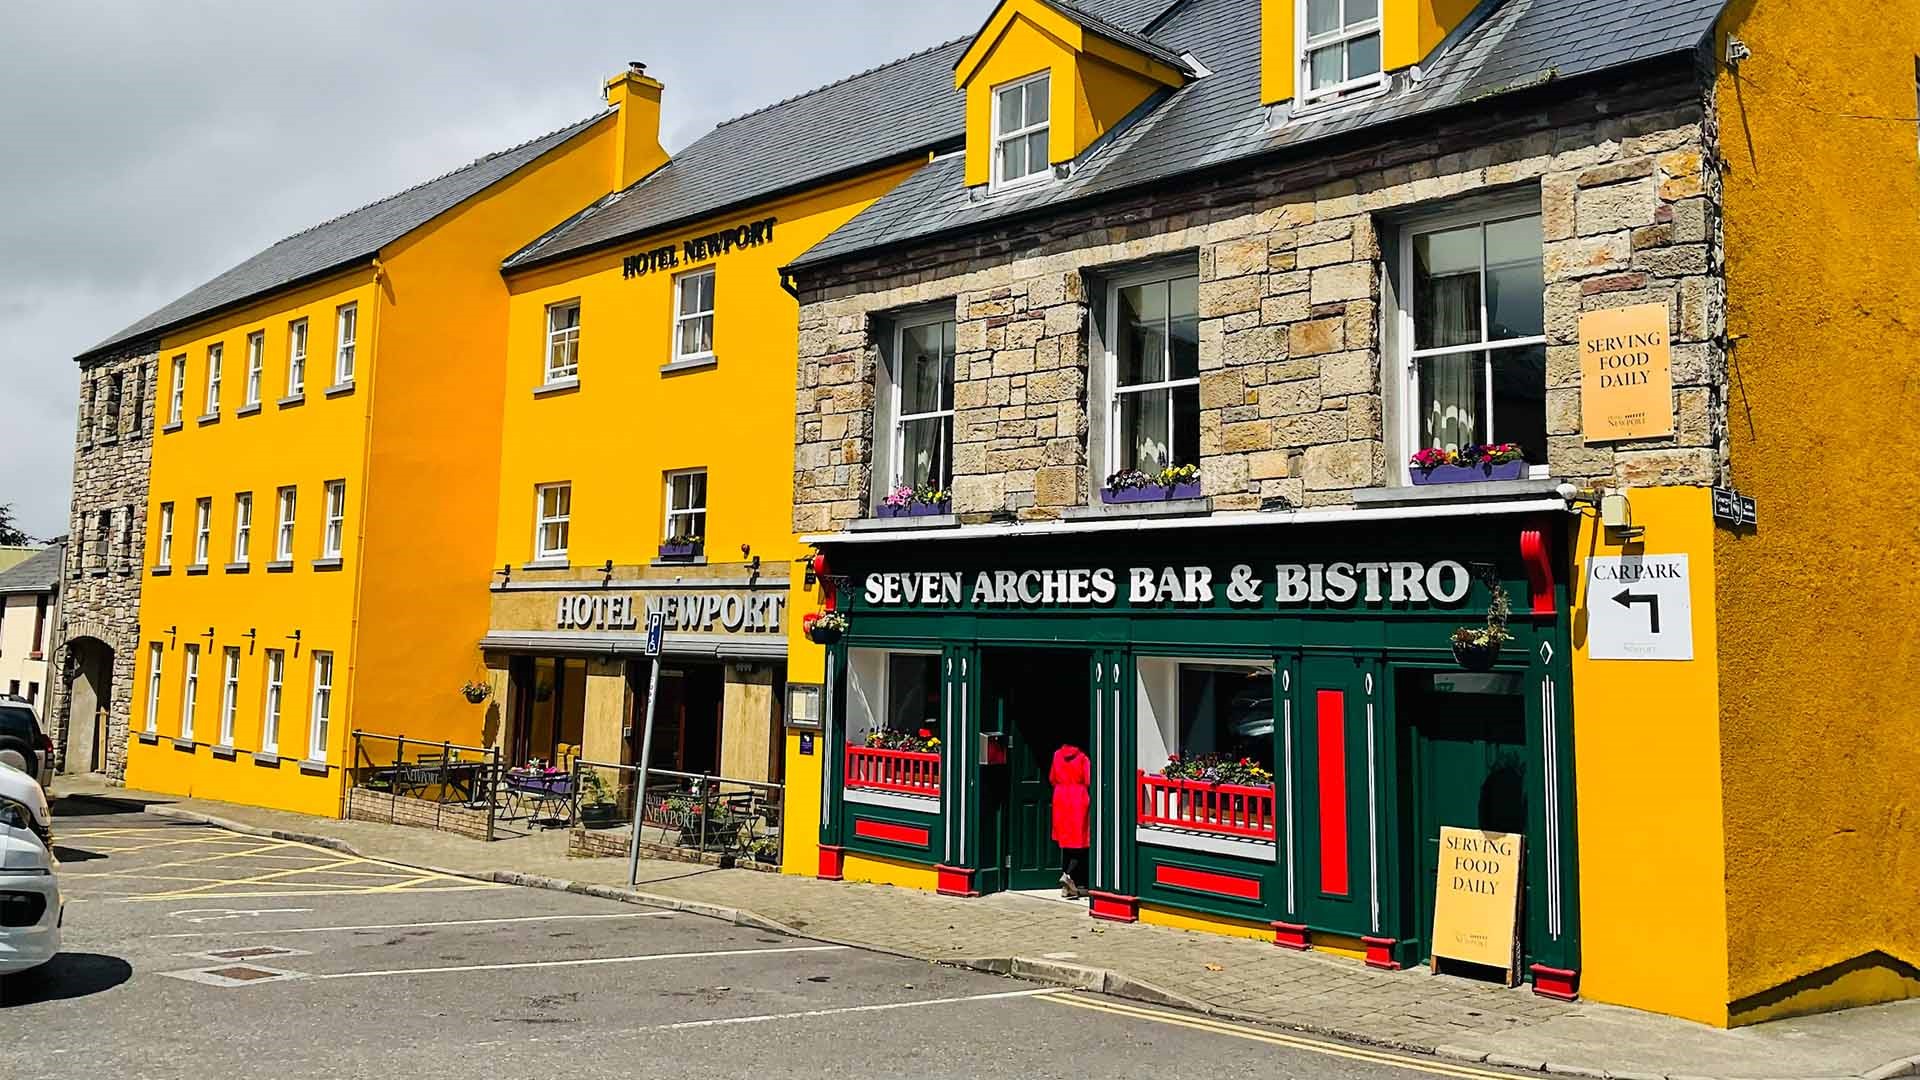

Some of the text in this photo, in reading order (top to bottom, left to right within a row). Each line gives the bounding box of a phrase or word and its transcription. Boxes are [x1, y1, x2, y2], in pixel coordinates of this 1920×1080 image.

[623, 216, 777, 280] HOTEL NEWPORT
[1587, 331, 1661, 354] SERVING
[1600, 352, 1649, 370] FOOD
[1600, 370, 1650, 388] DAILY
[864, 560, 1470, 604] SEVEN ARCHES BAR & BISTRO
[557, 594, 637, 629] HOTEL
[651, 615, 659, 632] P
[1446, 836, 1512, 857] SERVING
[1455, 856, 1500, 875] FOOD
[1453, 876, 1499, 896] DAILY
